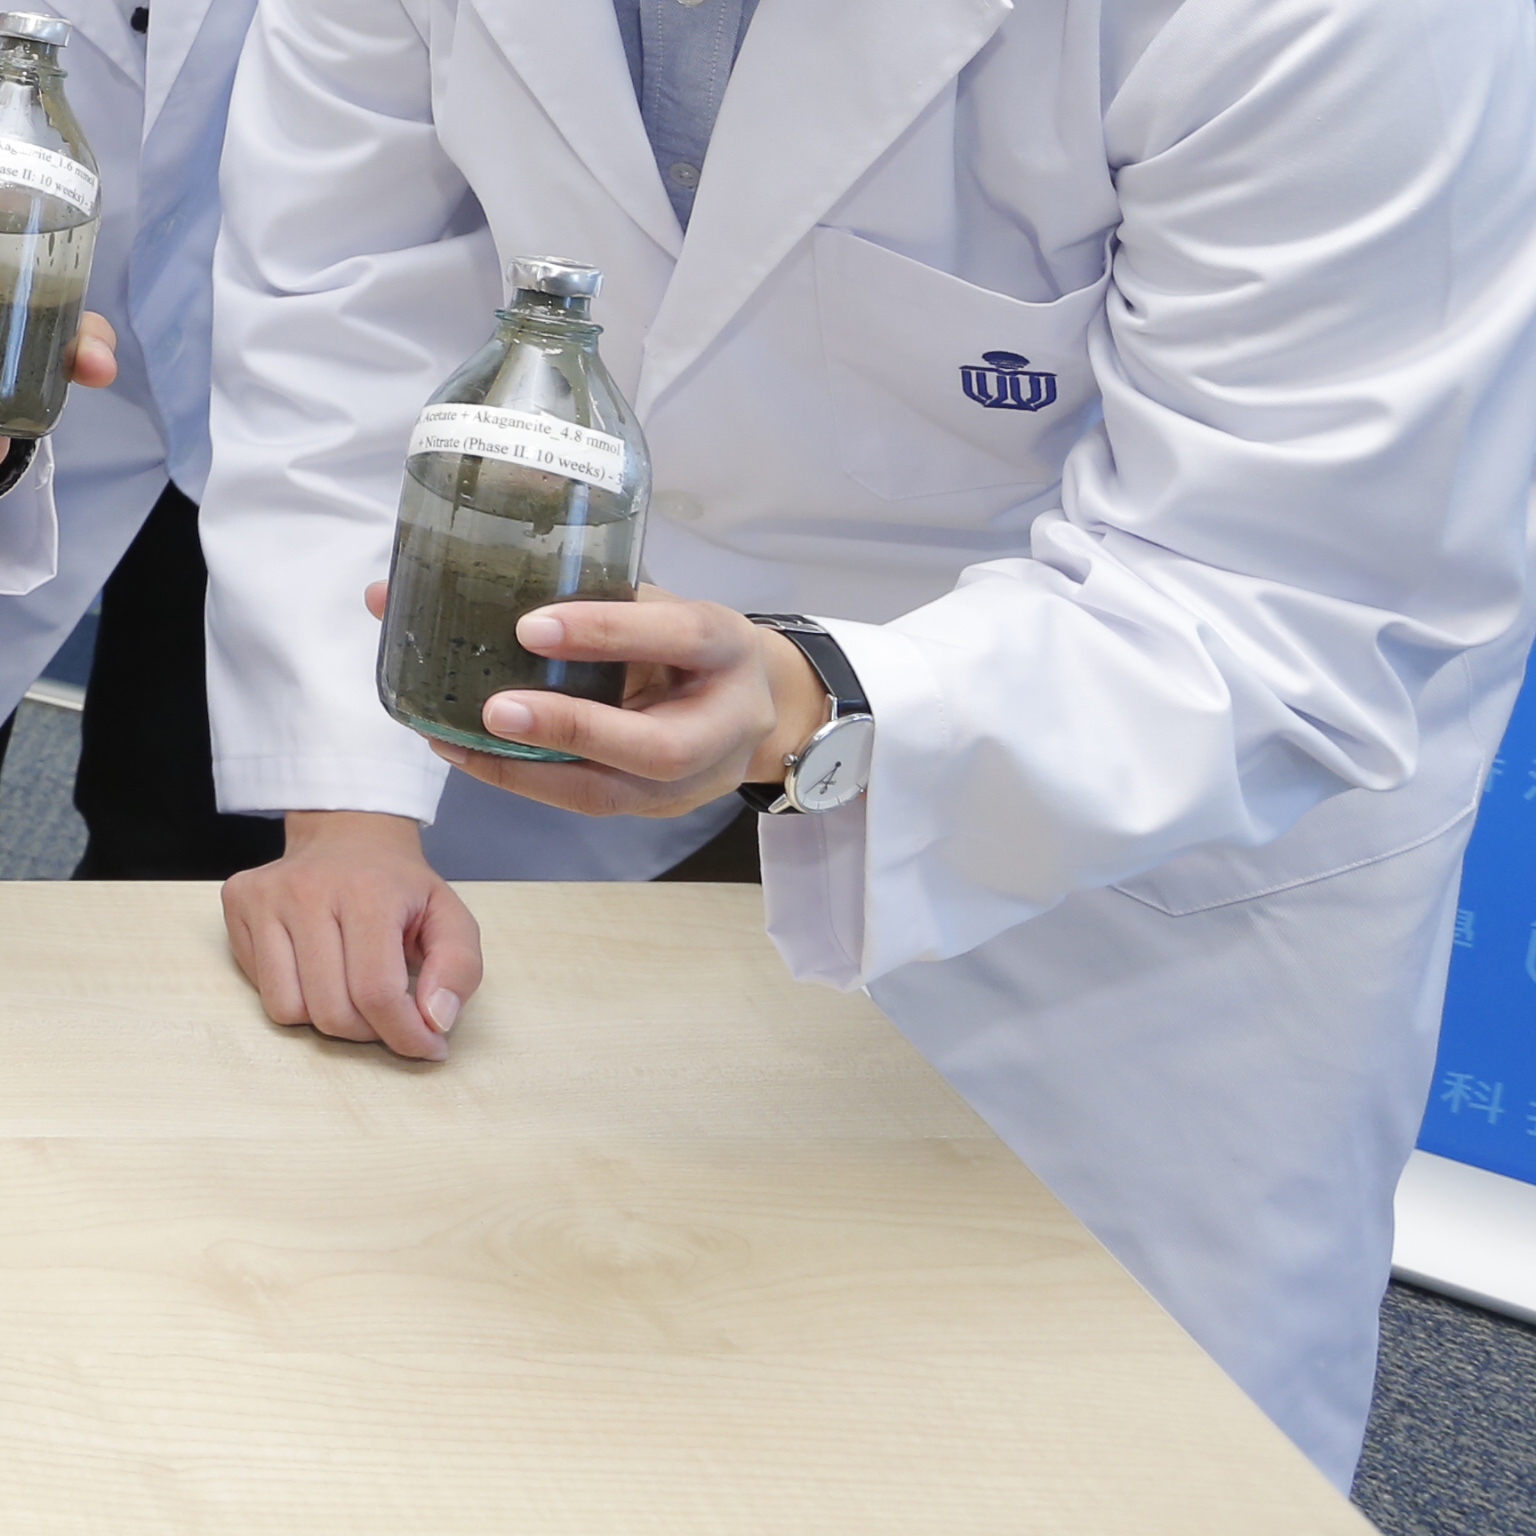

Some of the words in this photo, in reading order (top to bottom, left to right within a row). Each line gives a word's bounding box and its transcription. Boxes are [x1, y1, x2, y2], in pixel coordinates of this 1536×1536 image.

[22, 168, 35, 182] II:
[40, 174, 53, 187] 10
[423, 410, 457, 422] Acetate
[474, 410, 582, 443] Akaganeite_4.8
[586, 433, 621, 455] mmol
[425, 435, 460, 448] Nitrate
[463, 437, 509, 455] (Phase
[537, 449, 554, 464] 10
[558, 457, 605, 482] weeks)
